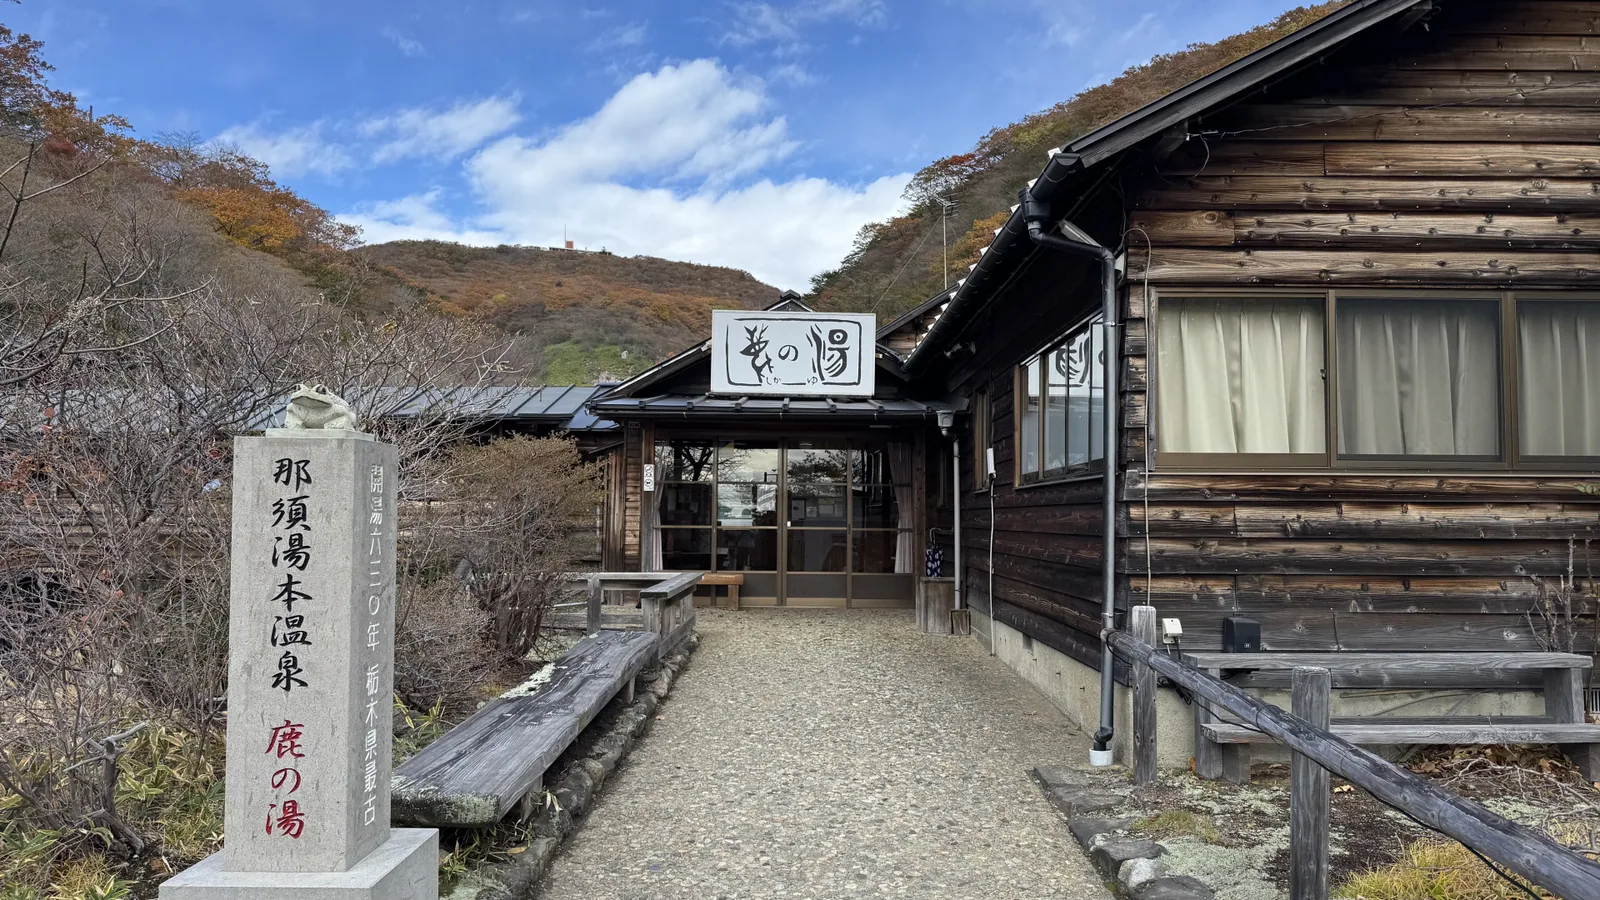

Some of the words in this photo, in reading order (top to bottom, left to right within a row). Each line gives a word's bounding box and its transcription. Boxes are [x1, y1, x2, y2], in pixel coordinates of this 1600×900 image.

[271, 458, 313, 692] 那須湯本温泉
[265, 720, 305, 839] 鹿の湯
[364, 663, 379, 826] 栃木県最古
